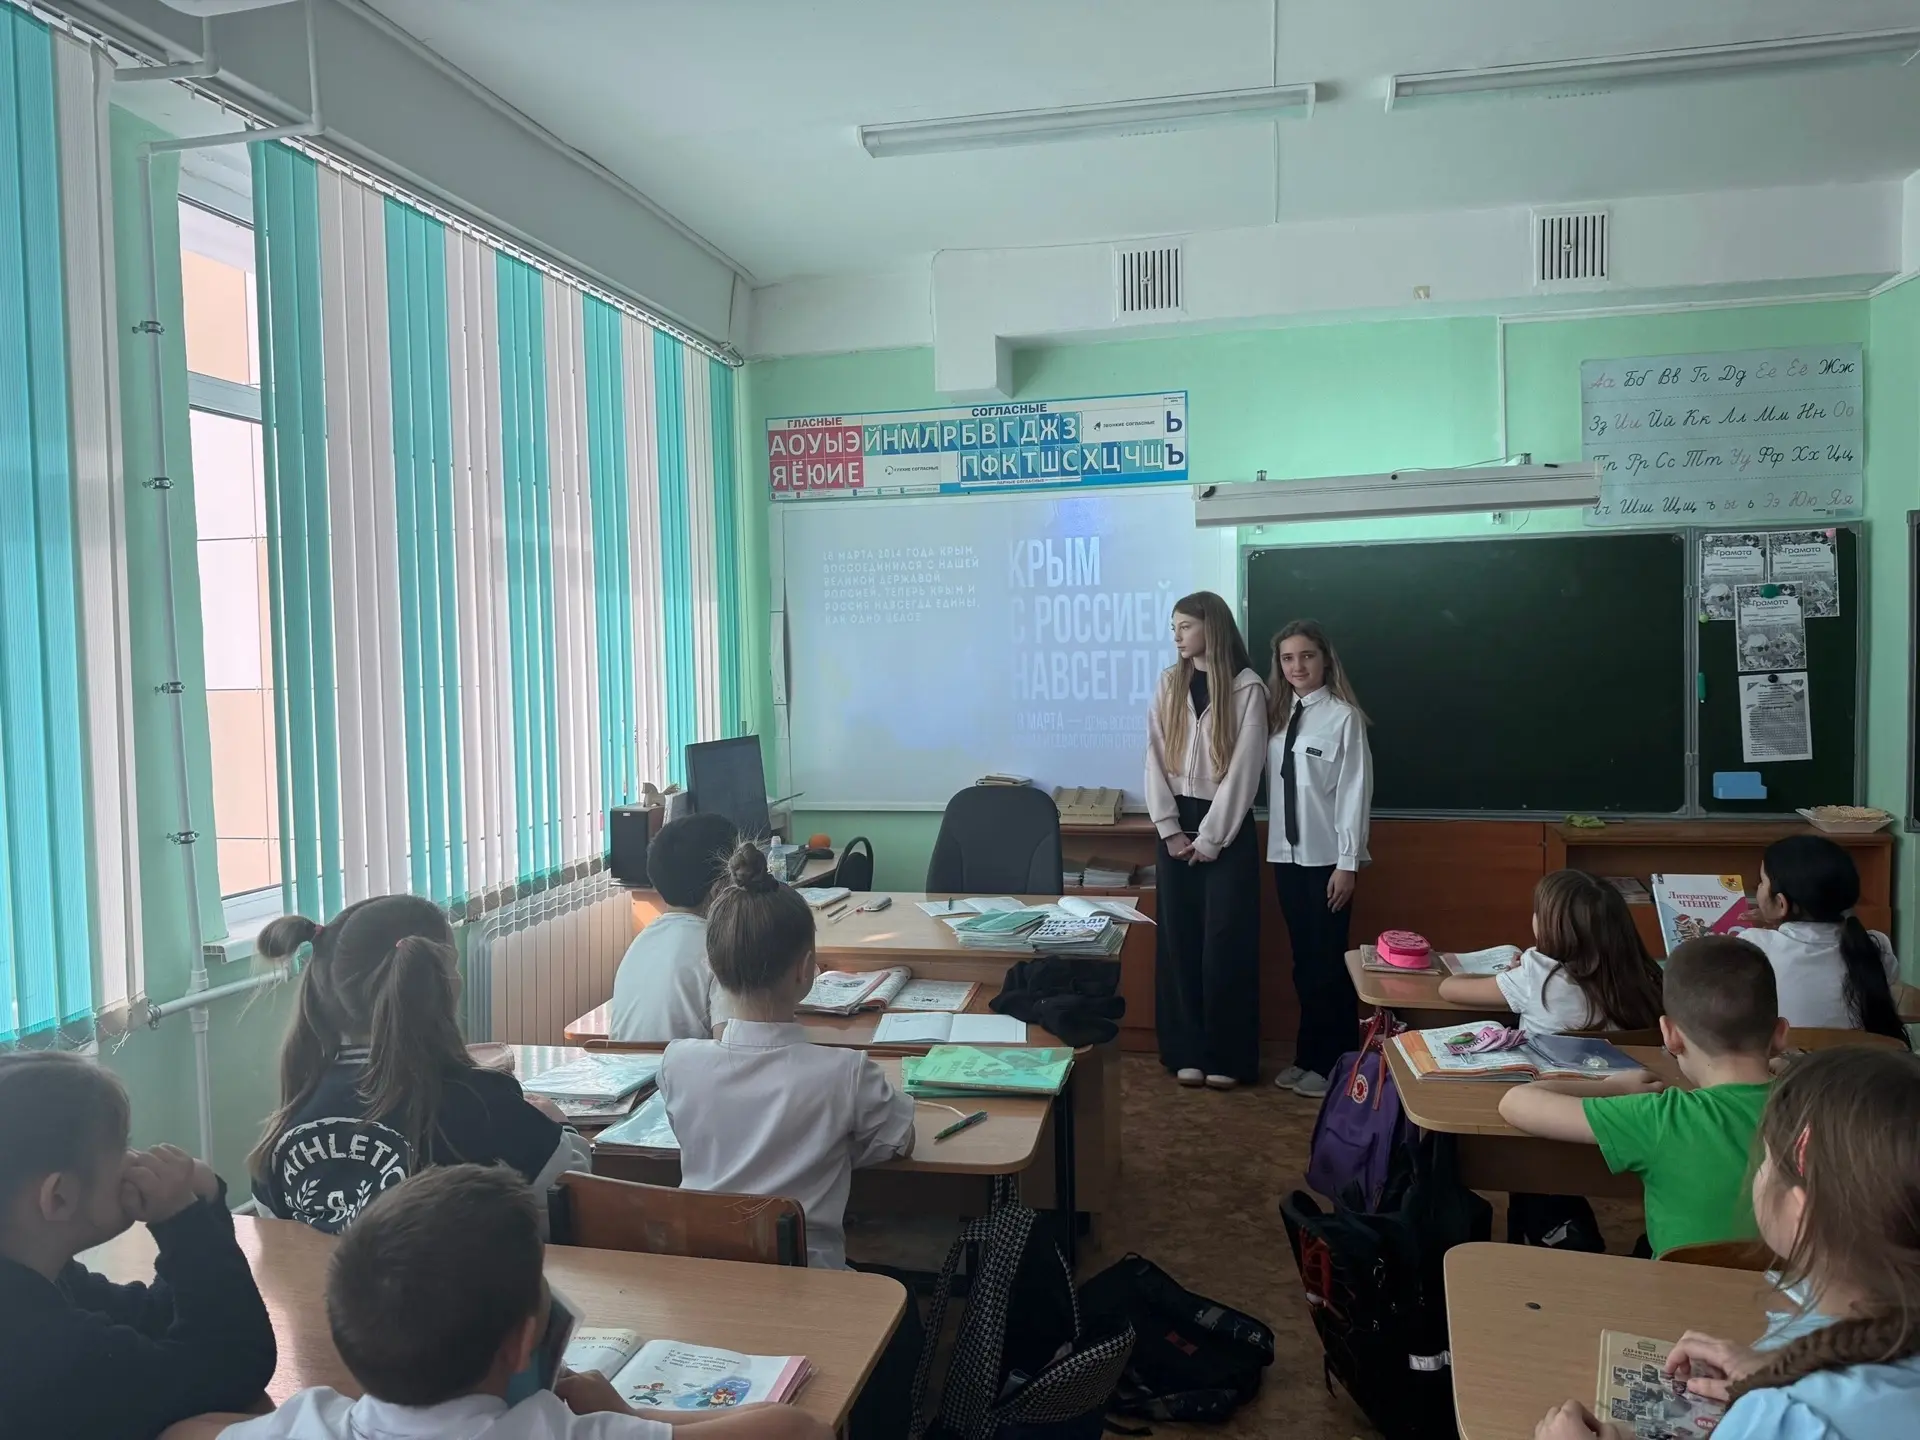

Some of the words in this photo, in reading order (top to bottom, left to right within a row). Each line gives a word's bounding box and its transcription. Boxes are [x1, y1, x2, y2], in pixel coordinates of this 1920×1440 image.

[1588, 372, 1616, 389] Аа
[1623, 369, 1655, 387] Бб
[1657, 367, 1682, 385] Вв
[1689, 365, 1711, 383] Гг
[1717, 364, 1747, 388] Дд
[1755, 361, 1777, 379] Ее
[1818, 358, 1855, 375] Жж
[971, 403, 1048, 418] СОГЛАСНЫЕ
[1589, 415, 1609, 437] Зз
[1614, 413, 1642, 430] Ии
[1648, 408, 1677, 428] Йй
[1682, 408, 1712, 426] Кк
[1717, 406, 1747, 424] Лл
[1753, 405, 1790, 422] Мм
[1796, 402, 1827, 420] Нн
[1833, 400, 1854, 418] Оо
[787, 416, 843, 429] ГЛАСНЫЕ
[1166, 410, 1183, 433] Ь
[1625, 453, 1650, 476] Рр
[1655, 451, 1676, 469] Сс
[1682, 449, 1723, 468] Тт
[1730, 448, 1751, 472] Уу
[1757, 446, 1785, 469] Фф
[1791, 444, 1820, 462] Хх
[1826, 444, 1856, 462] Цц
[1620, 497, 1654, 514] Шш
[1663, 496, 1697, 514] Щщ
[1763, 492, 1780, 508] Ээ
[1788, 489, 1818, 507] Юю
[1827, 488, 1854, 506] Яя
[838, 549, 874, 561] МАРТА
[878, 548, 902, 560] 2014
[906, 547, 934, 558] ГОДА
[940, 545, 973, 557] КРЫМ
[1715, 548, 1752, 557] Грамота
[1784, 546, 1821, 554] Грамота
[823, 561, 922, 573] ВОССОЕДИНИЛСЯ
[927, 560, 935, 570] С
[938, 555, 980, 569] НАШЕЙ
[1008, 536, 1101, 588] КРЫМ
[824, 573, 875, 586] ВЕЛИКОЙ
[879, 570, 941, 585] ДЕРЖАВОЙ
[885, 586, 926, 597] ТЕПЕРЬ
[930, 584, 963, 596] КРЫМ
[968, 583, 975, 594] И
[825, 601, 870, 612] РОССИЯ
[875, 599, 932, 610] НАВСЕГДА
[1752, 599, 1789, 607] Грамота
[825, 614, 847, 626] КАК
[851, 613, 882, 624] ОДНО
[885, 612, 922, 624] ЦЕЛОЕ
[1010, 595, 1026, 644] С
[1035, 580, 1174, 644] РОССИЕЙ
[1027, 711, 1065, 731] МАРТА
[1668, 891, 1729, 901] Литературное
[1678, 901, 1722, 909] ЧТЕНИЕ
